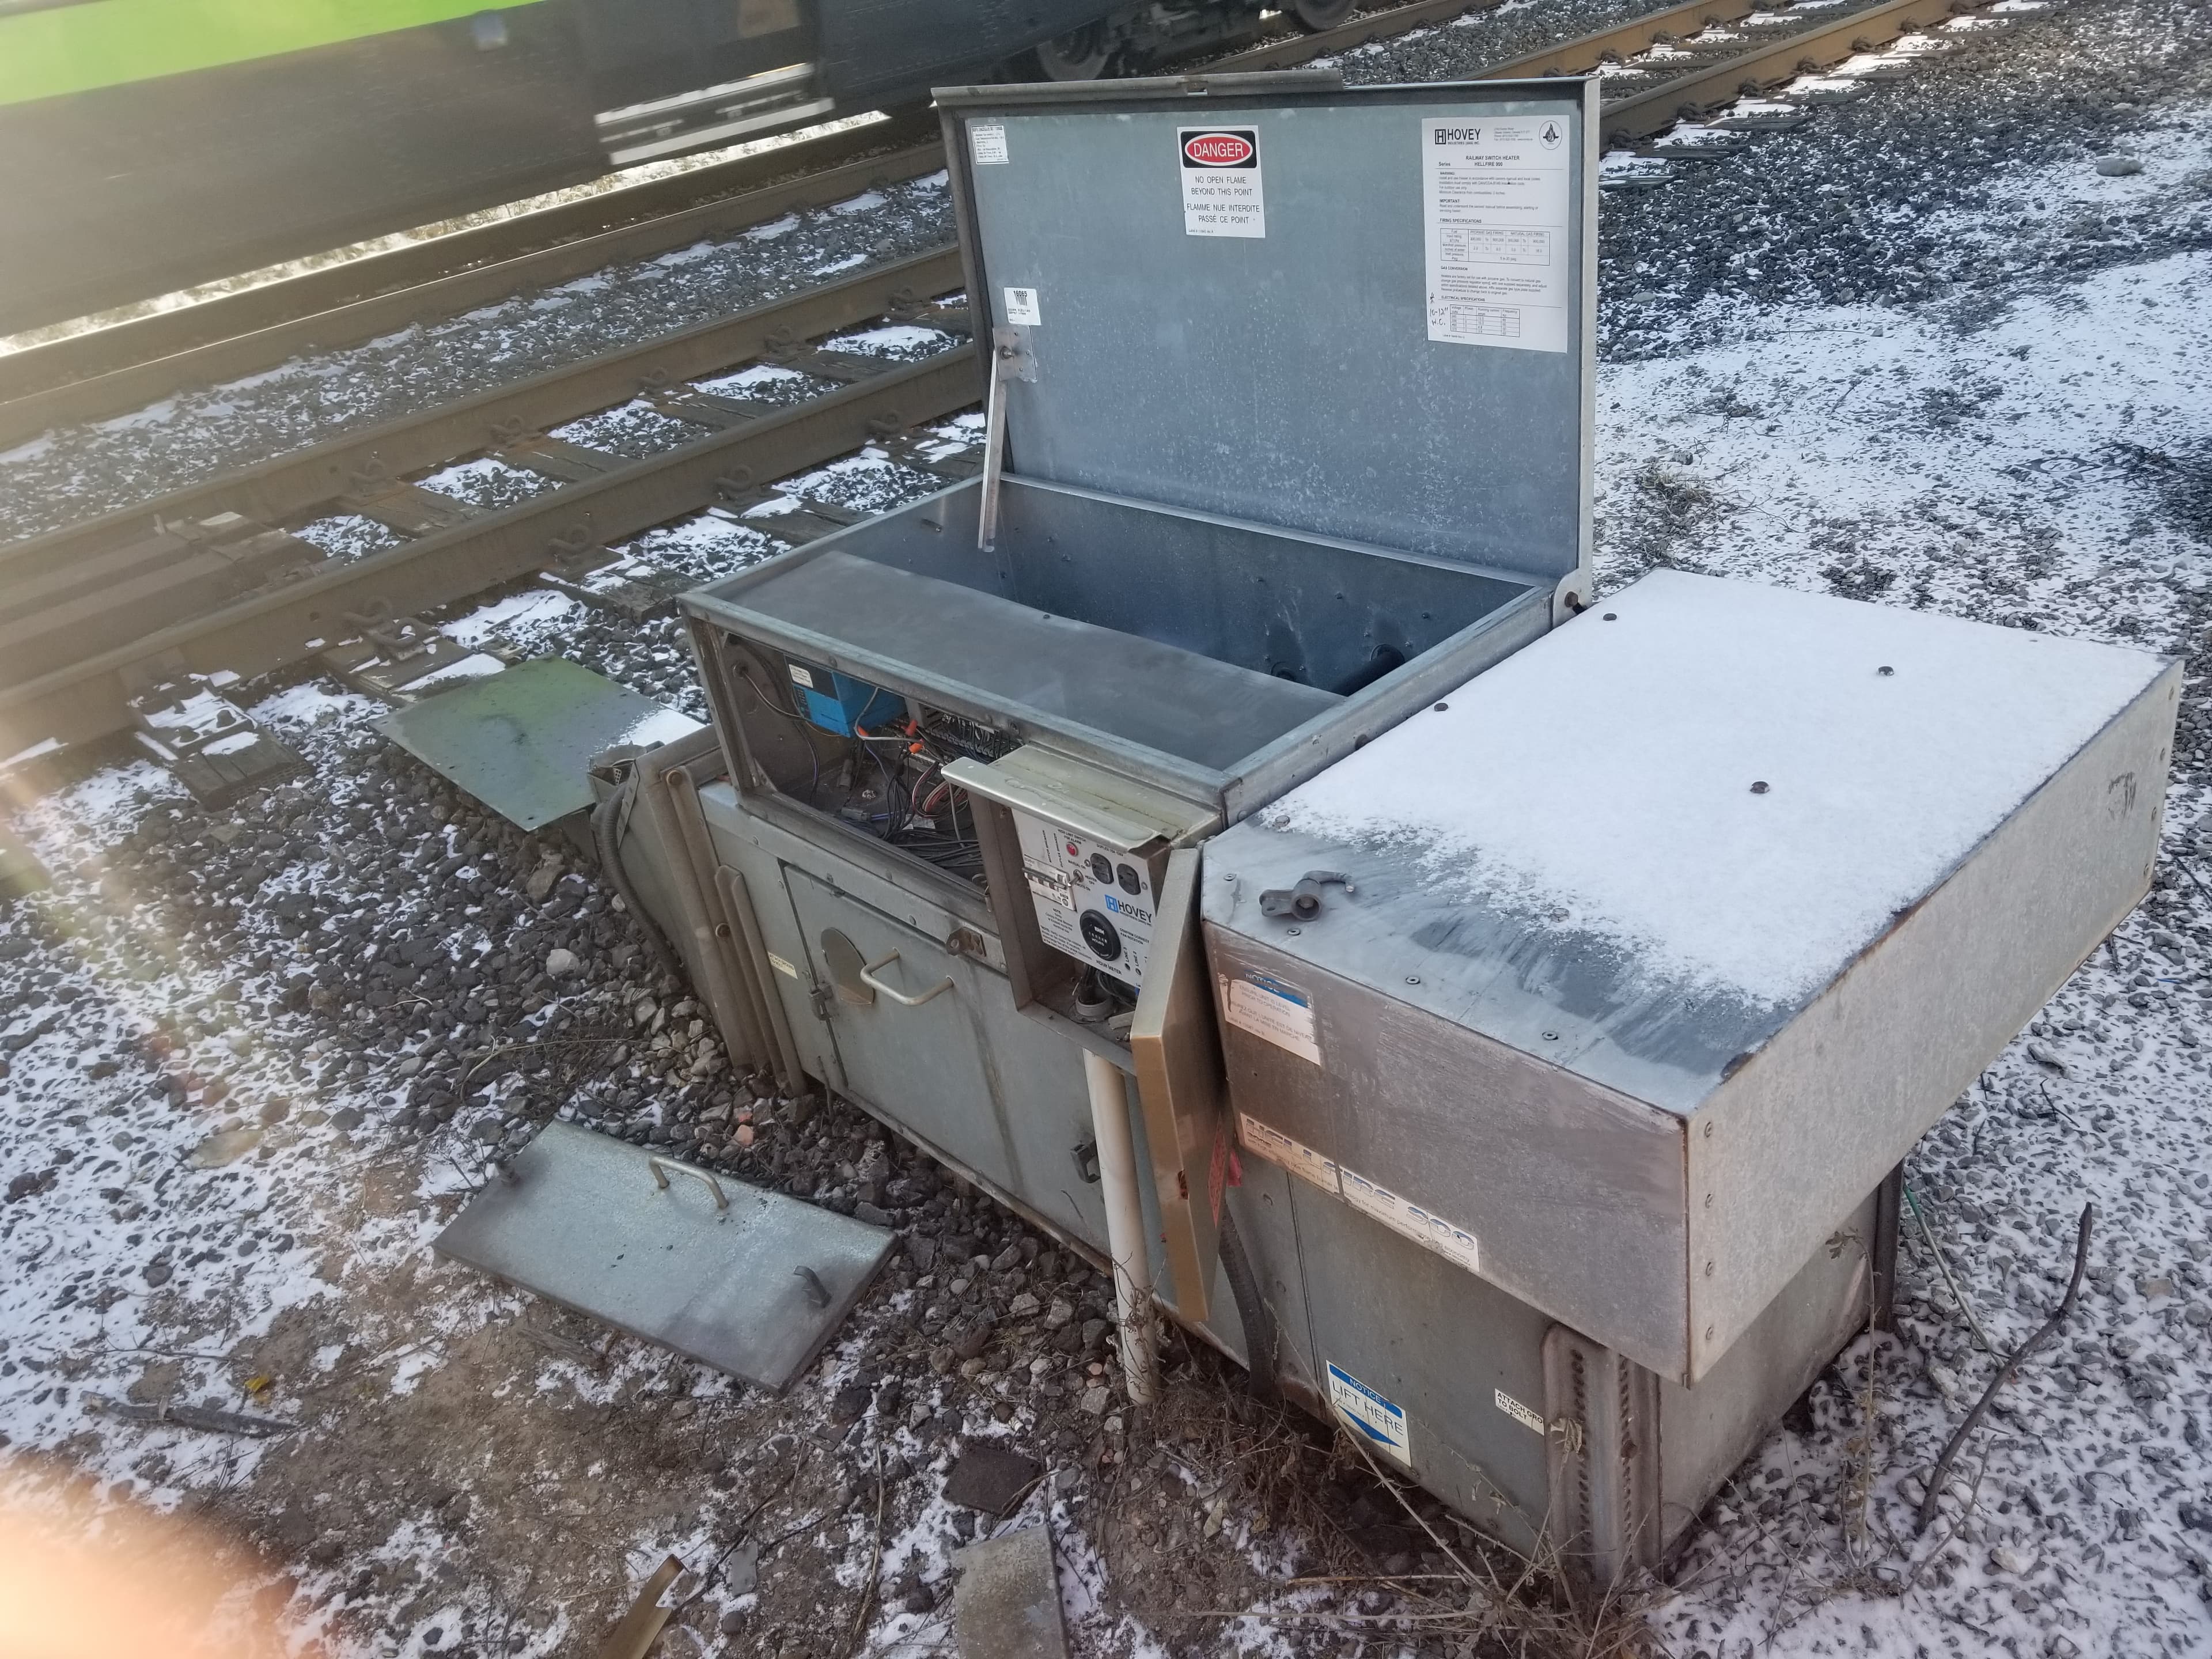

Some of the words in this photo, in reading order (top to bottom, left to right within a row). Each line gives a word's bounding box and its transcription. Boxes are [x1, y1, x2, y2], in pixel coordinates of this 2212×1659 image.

[1448, 128, 1481, 140] HOVEY
[1194, 142, 1244, 157] DANGER
[1187, 203, 1212, 211] FLAMME
[1199, 214, 1217, 223] PASSÉ
[1118, 900, 1152, 923] HOVEY
[1350, 1378, 1381, 1404] NOTICE
[1332, 1380, 1360, 1406] LIFT
[1364, 1401, 1404, 1436] HERE
[1498, 1392, 1525, 1414] ATTACH
[1498, 1397, 1508, 1407] TO
[1509, 1405, 1527, 1420] BOLT
